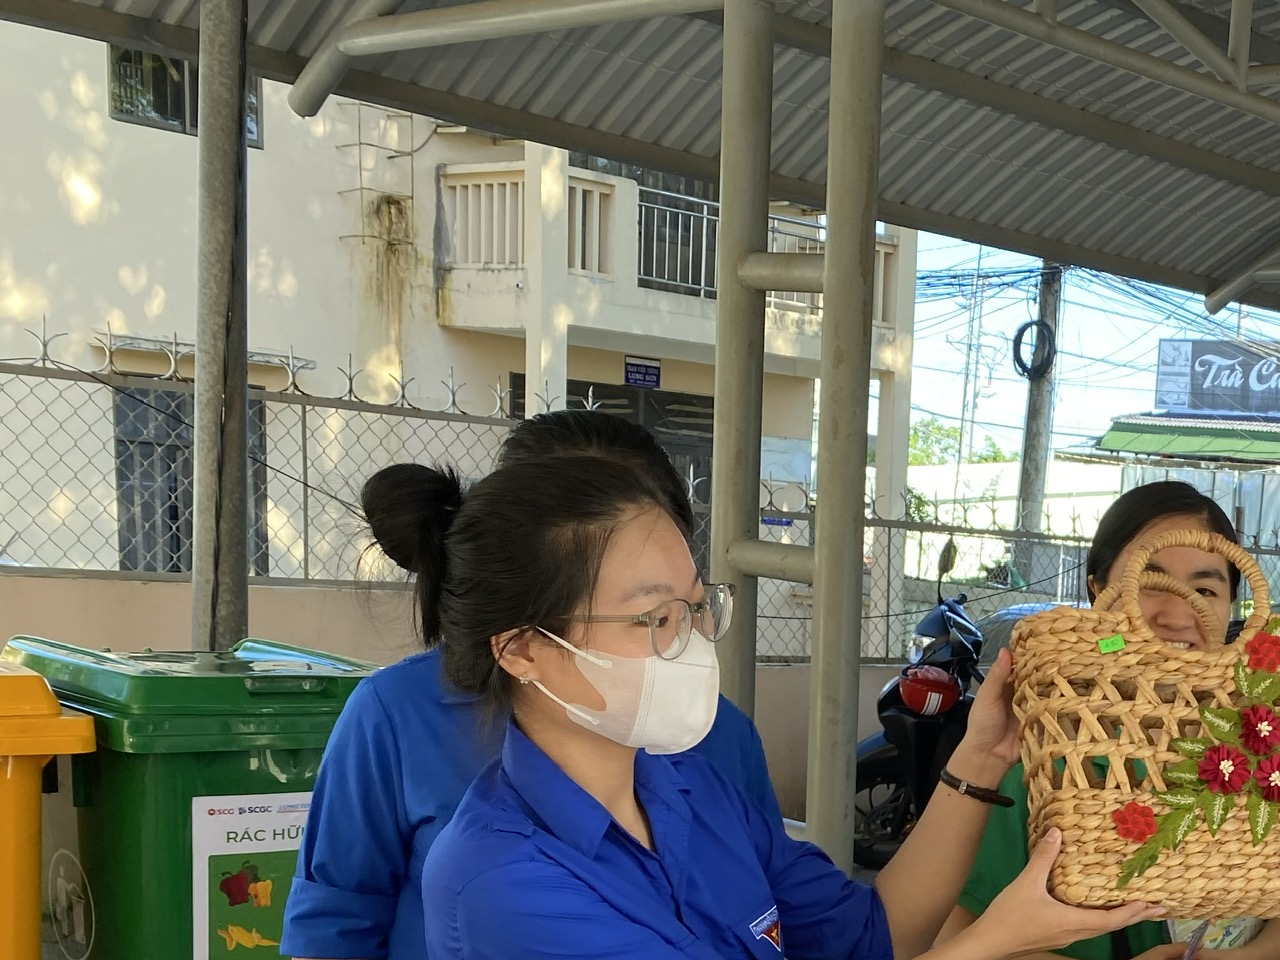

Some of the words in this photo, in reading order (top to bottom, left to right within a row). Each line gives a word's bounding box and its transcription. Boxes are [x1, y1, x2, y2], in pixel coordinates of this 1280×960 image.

[1194, 354, 1244, 389] Trà
[247, 805, 273, 814] SCGC
[226, 827, 267, 843] RÁC
